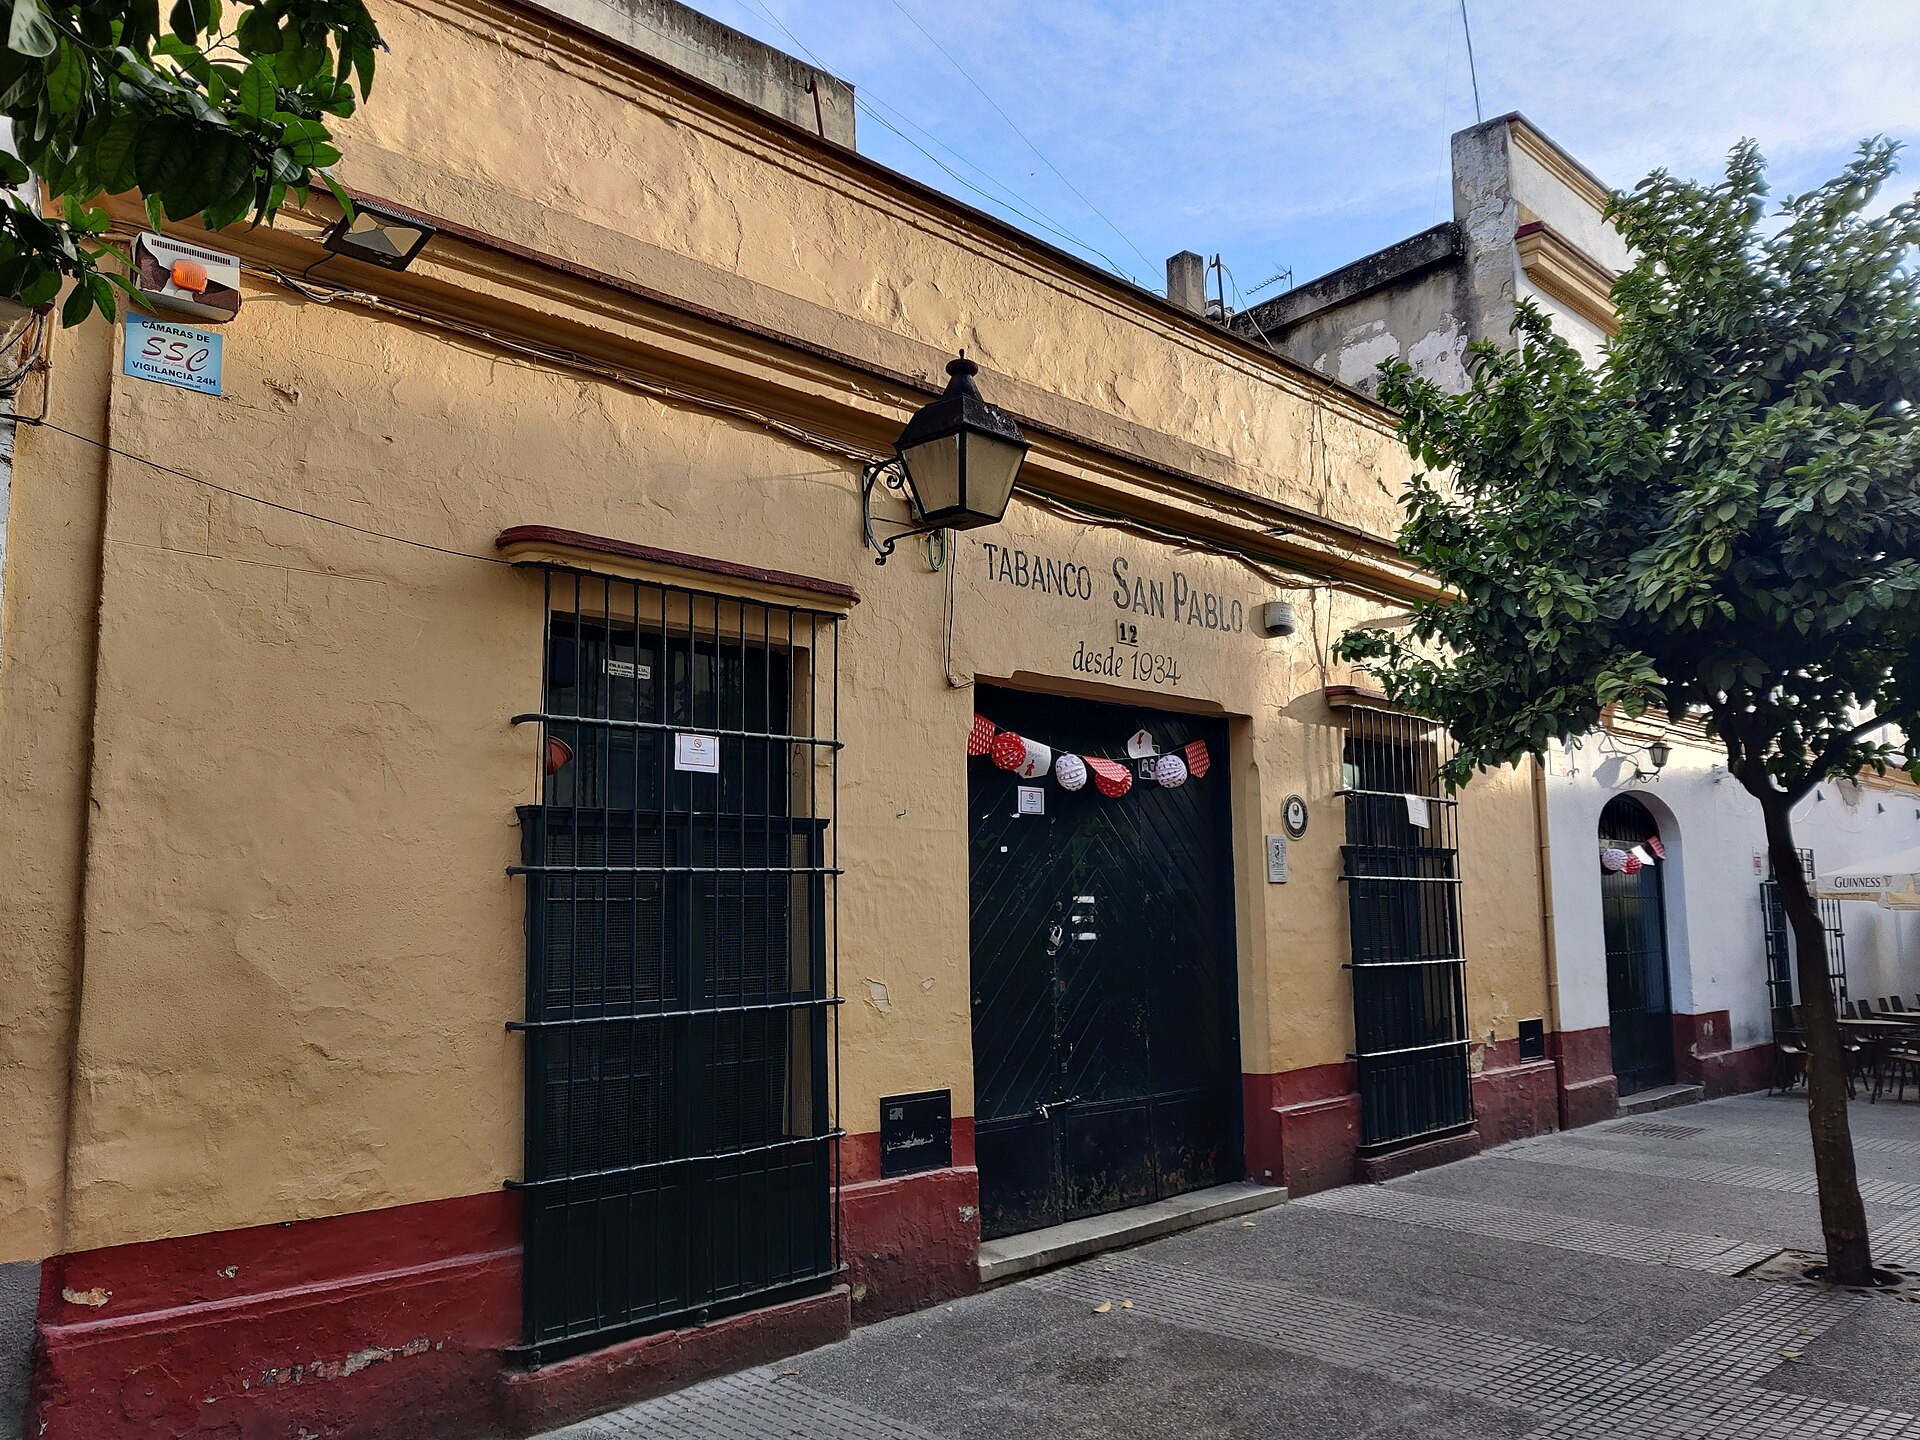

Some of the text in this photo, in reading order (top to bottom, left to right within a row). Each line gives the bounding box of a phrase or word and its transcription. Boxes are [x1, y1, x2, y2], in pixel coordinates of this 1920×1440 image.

[141, 320, 210, 343] CÁMARAS DE
[141, 336, 209, 372] SSC
[132, 360, 216, 386] VIGILANCIA 24H
[983, 542, 1243, 634] TABANCO SAN PABLO
[1119, 622, 1138, 644] 12
[1072, 640, 1182, 686] desde 1934
[1834, 876, 1881, 889] GUINNESS
